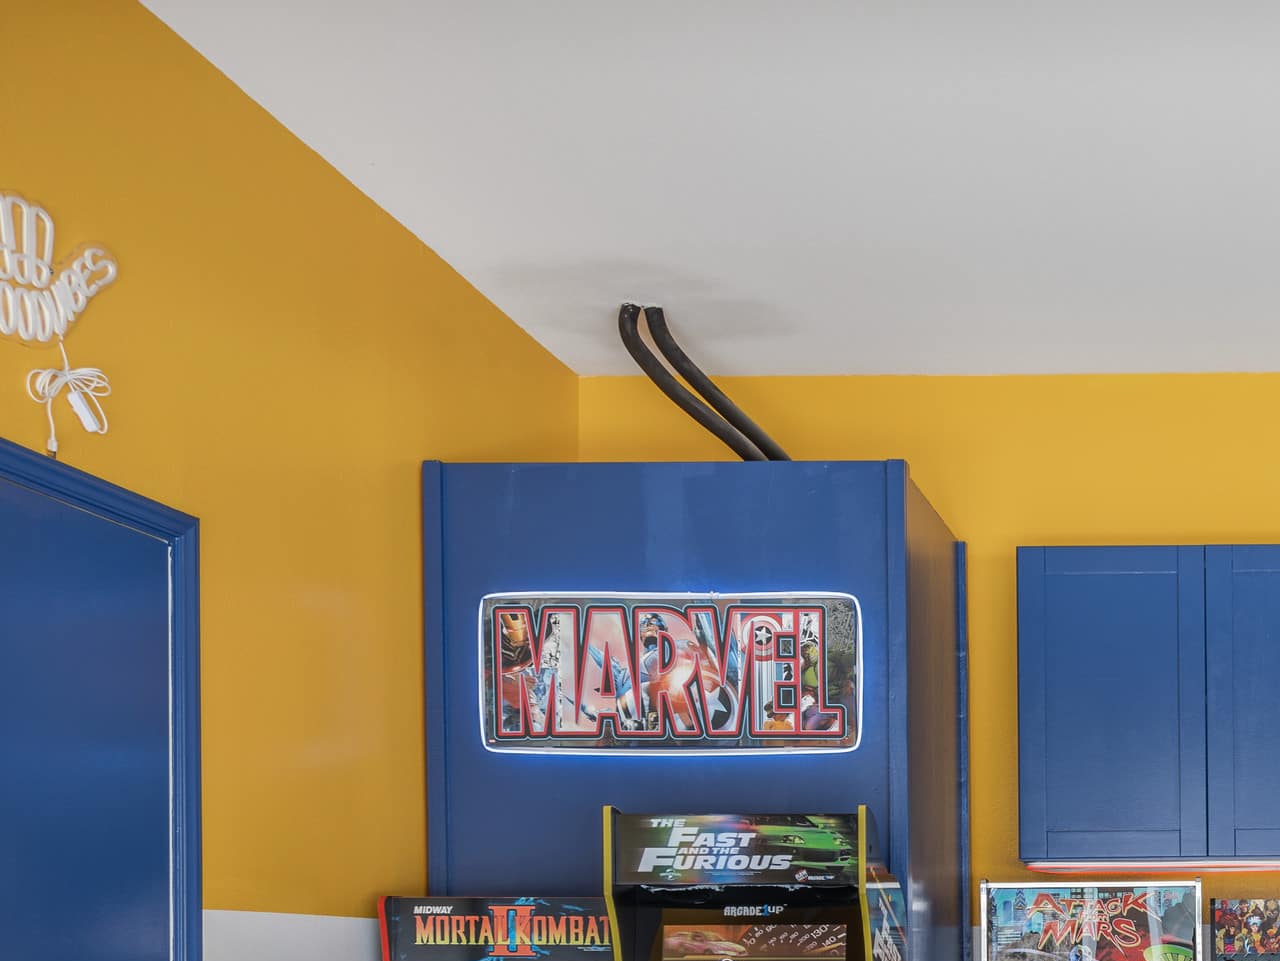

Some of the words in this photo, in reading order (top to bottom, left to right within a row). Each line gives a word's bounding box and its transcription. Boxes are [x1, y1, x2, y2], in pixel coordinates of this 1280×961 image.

[492, 604, 848, 741] MARVEL
[650, 819, 686, 828] THE
[667, 827, 757, 848] FAST
[637, 848, 793, 873] FURIOUS
[678, 847, 708, 855] AND
[711, 847, 740, 855] THE
[413, 905, 453, 914] MIDWAY
[1026, 891, 1162, 922] ATTACK
[414, 915, 511, 945] MORTAL
[512, 915, 611, 945] KOMBAT
[811, 924, 829, 938] 130
[1037, 918, 1142, 958] MARS
